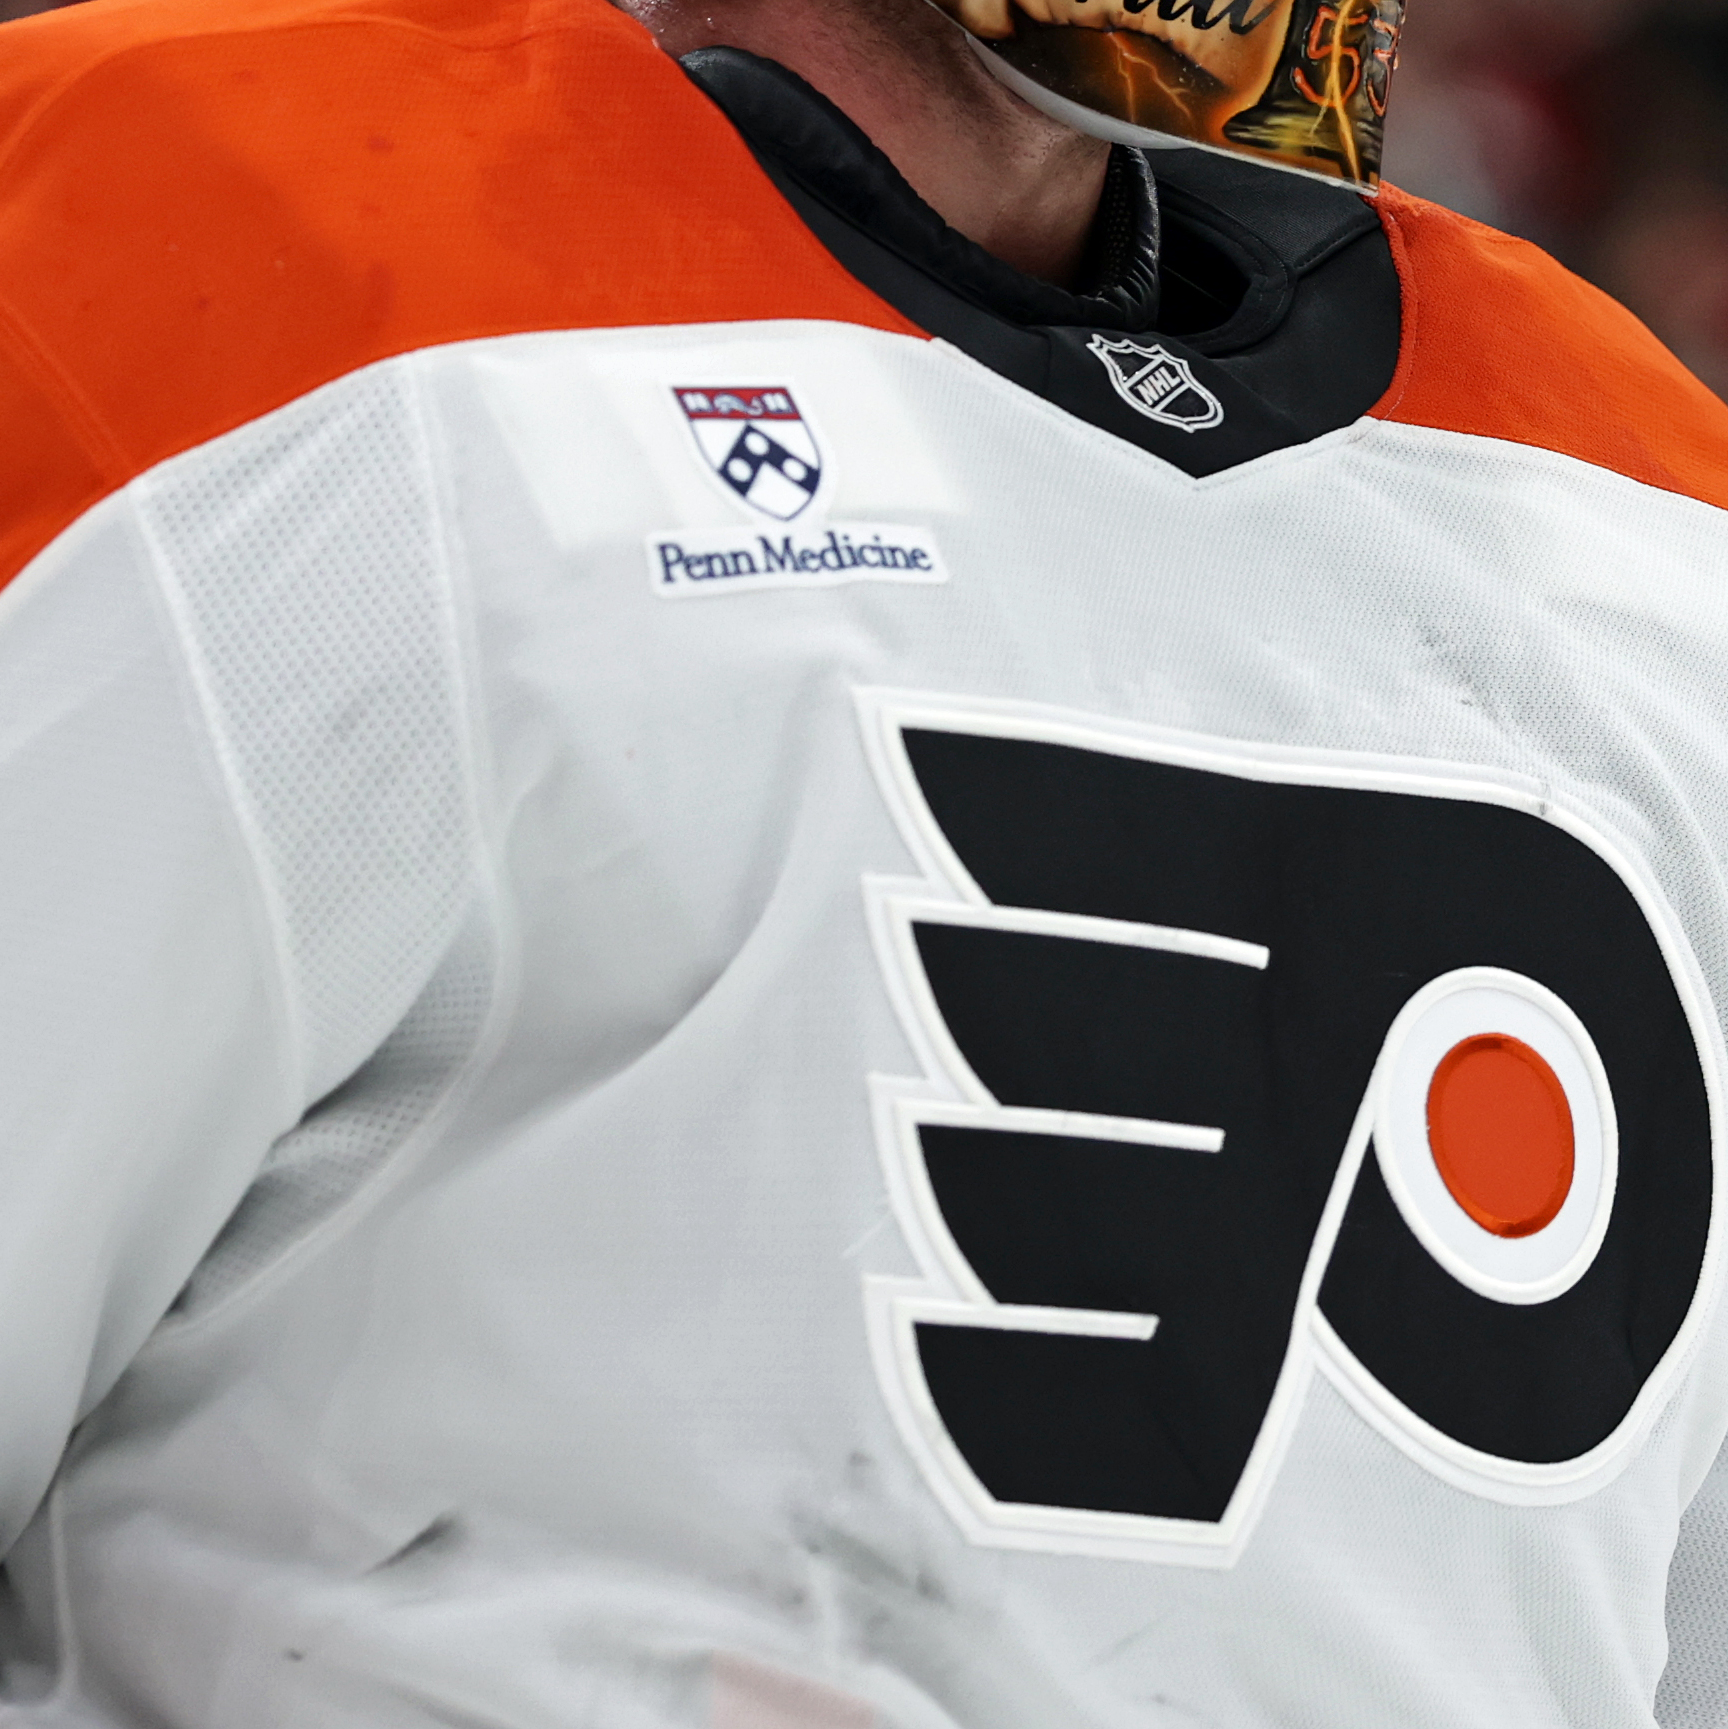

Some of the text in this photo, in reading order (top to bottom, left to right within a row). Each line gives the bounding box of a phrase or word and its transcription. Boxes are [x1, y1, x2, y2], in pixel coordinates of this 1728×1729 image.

[1134, 366, 1182, 406] NHL
[657, 530, 933, 584] Penn Medicine
